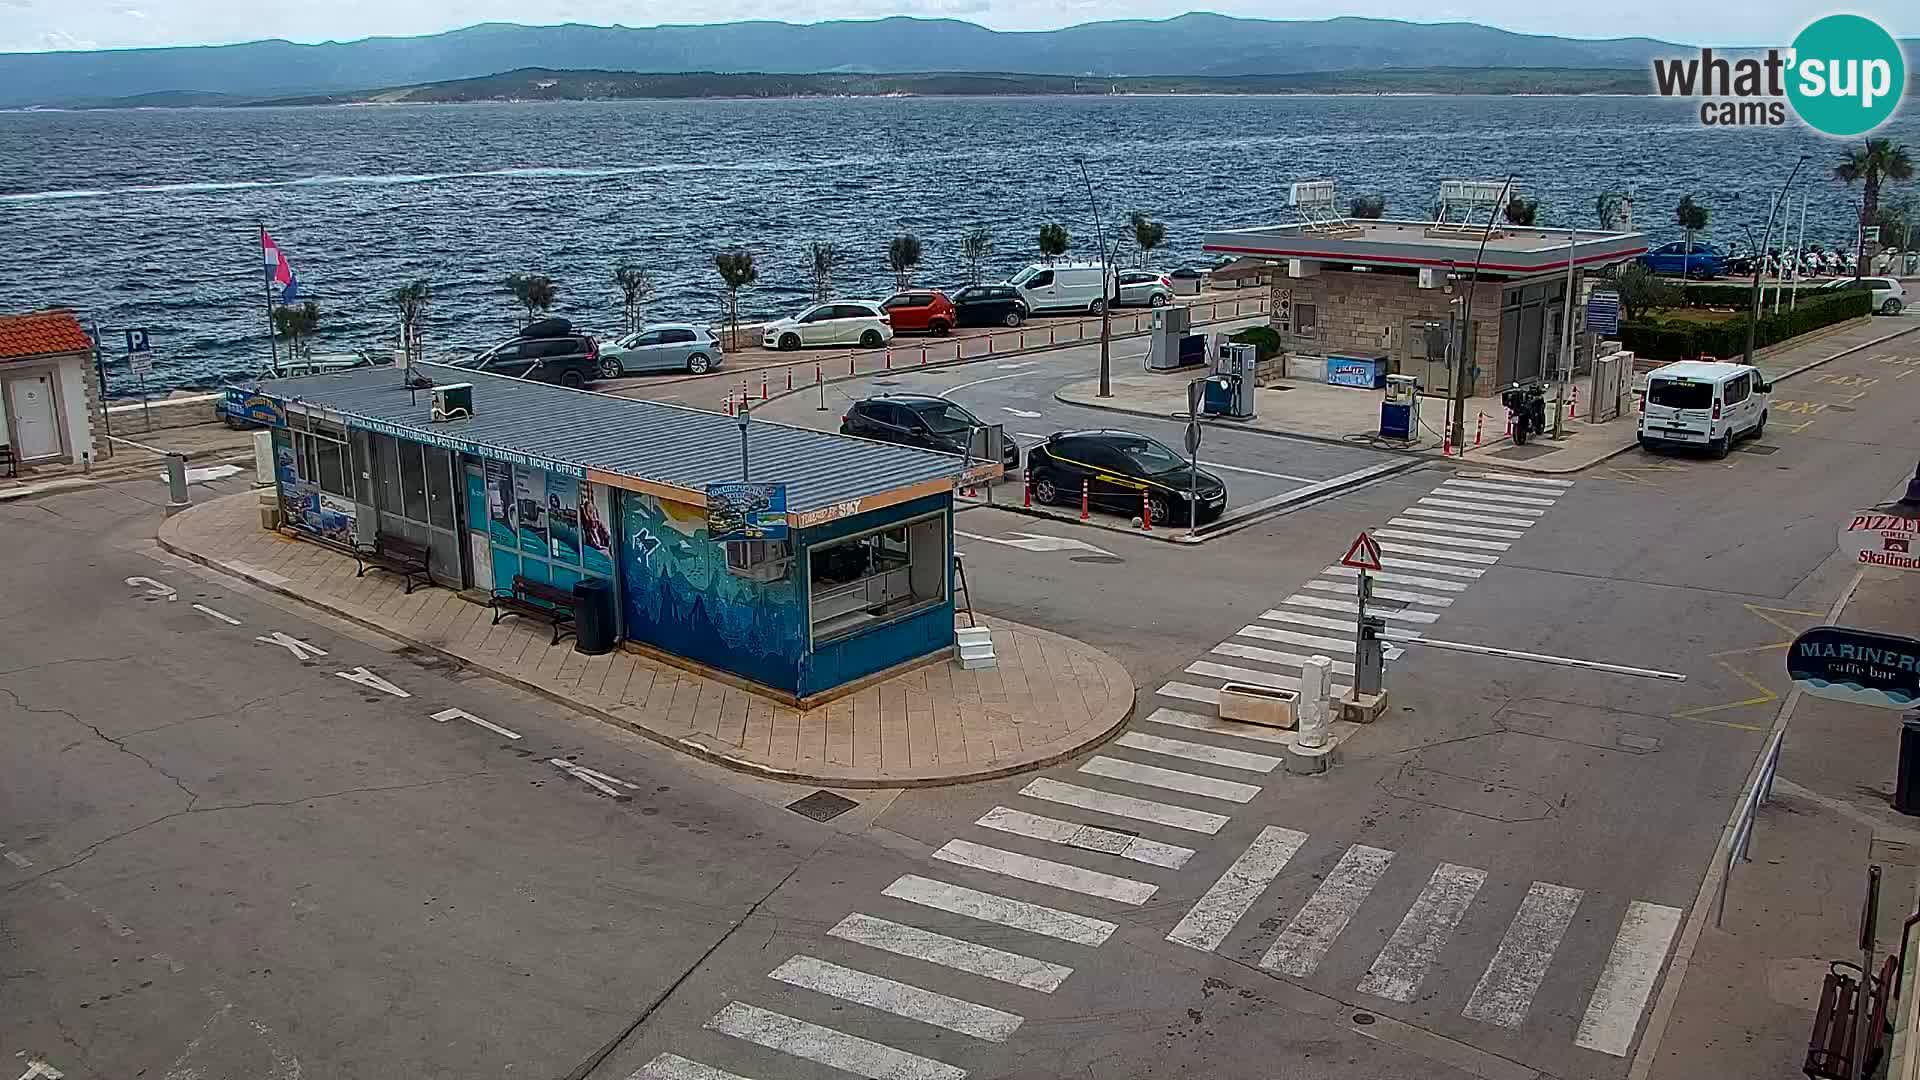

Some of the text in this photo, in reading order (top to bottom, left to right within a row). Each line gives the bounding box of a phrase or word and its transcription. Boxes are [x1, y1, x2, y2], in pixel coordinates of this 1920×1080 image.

[132, 331, 143, 349] P
[478, 446, 494, 457] BUS
[494, 449, 526, 464] STATION
[529, 457, 554, 470] TICKET
[555, 463, 583, 477] OFFICE
[1848, 515, 1920, 533] PIZZE
[1870, 665, 1896, 680] bar
